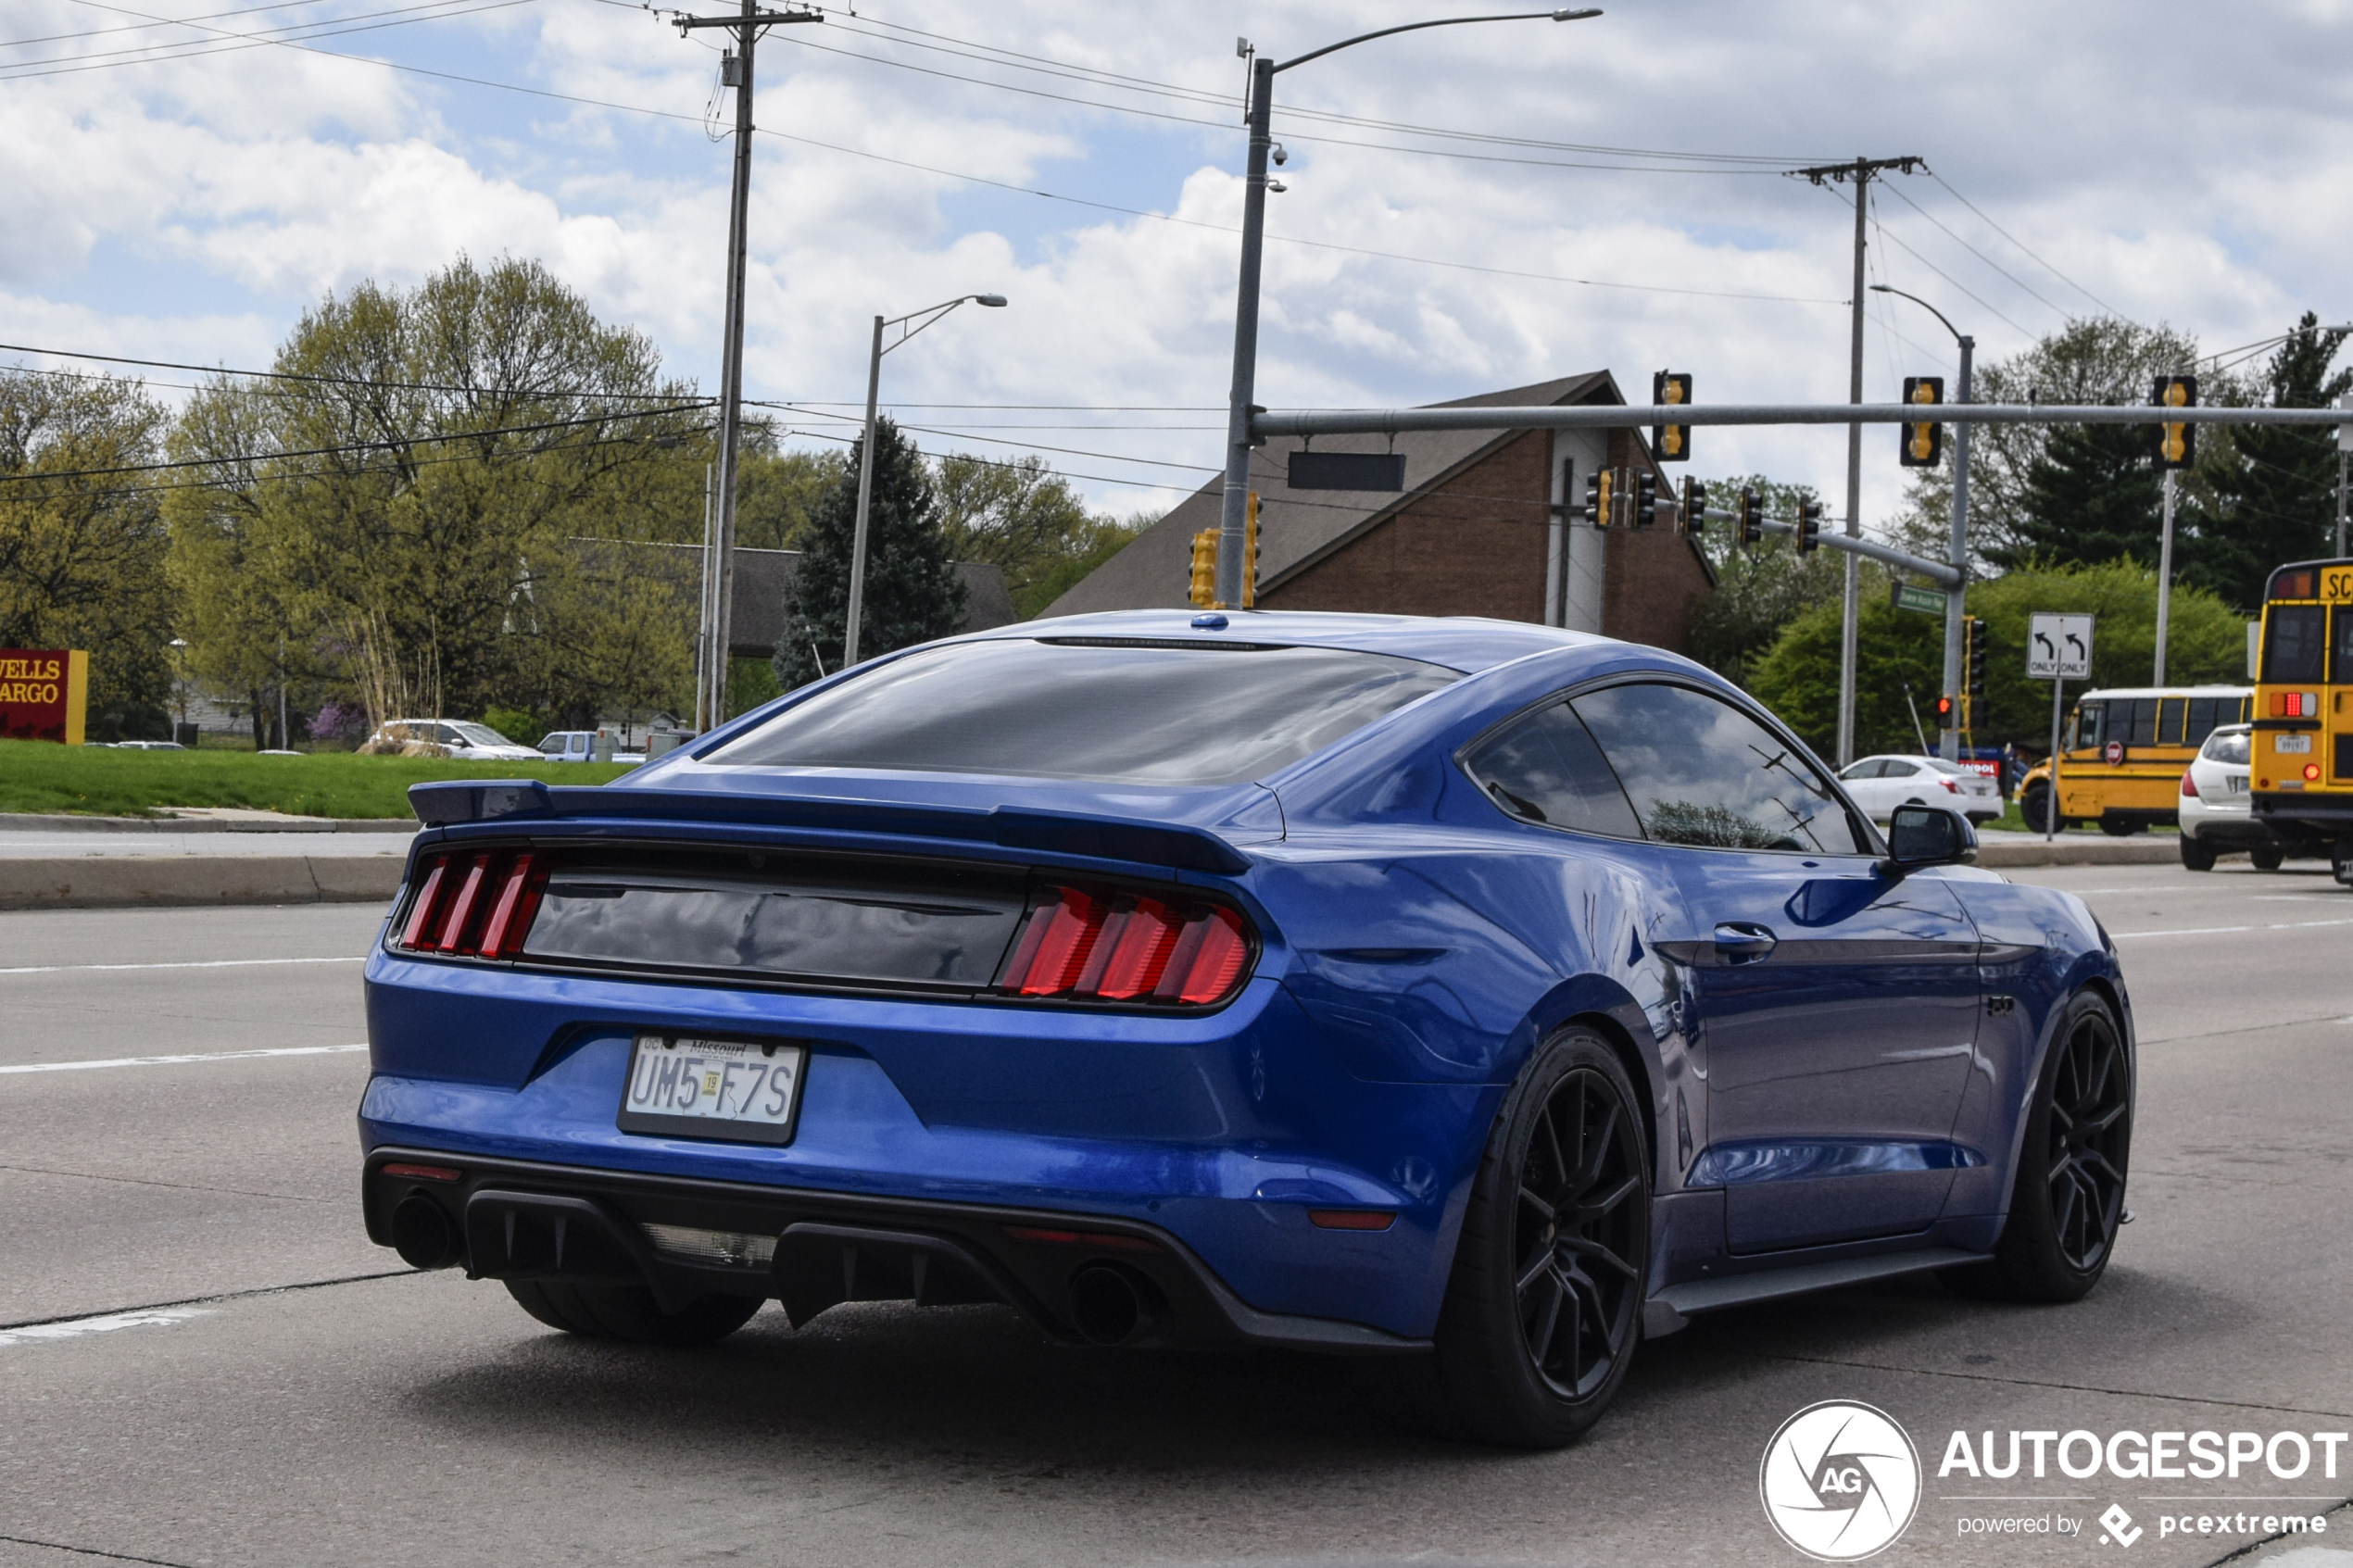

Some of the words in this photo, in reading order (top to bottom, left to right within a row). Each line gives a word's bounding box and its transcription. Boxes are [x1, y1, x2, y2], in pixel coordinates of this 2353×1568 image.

[2032, 661, 2056, 672] ONLY
[2060, 662, 2086, 673] ONLY
[689, 1039, 748, 1058] Missouri
[633, 1054, 704, 1109] UM5
[715, 1061, 791, 1116] F7S
[707, 1076, 717, 1089] 19
